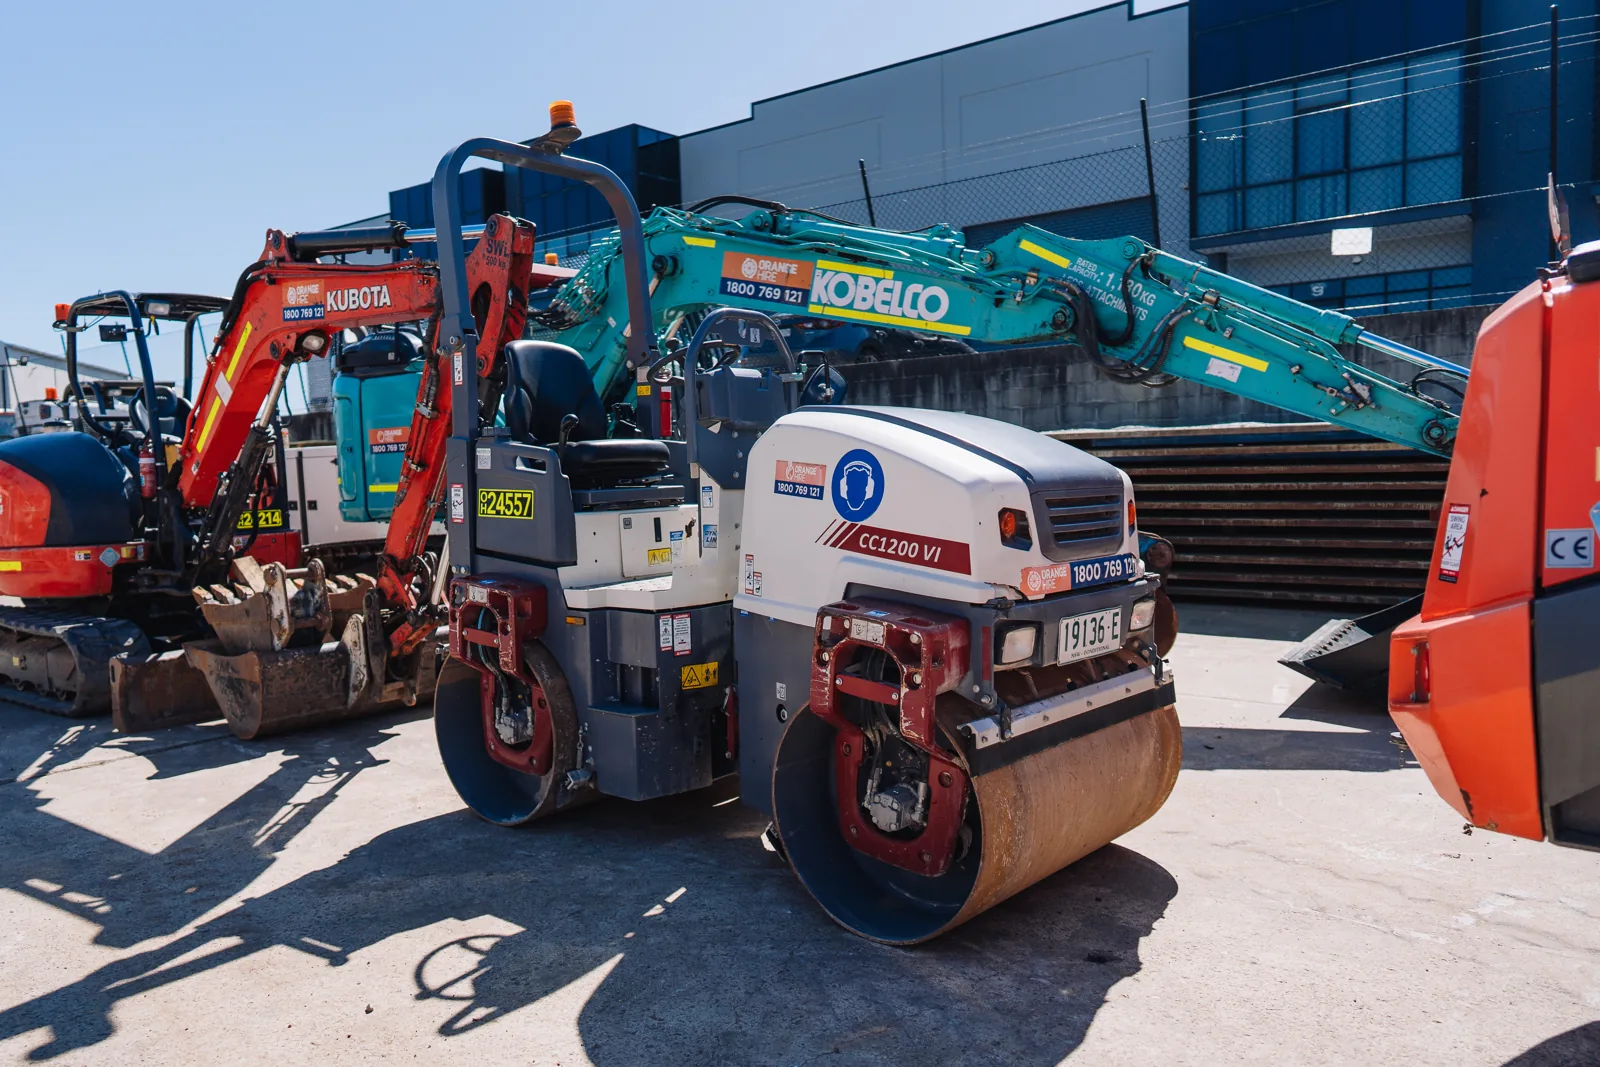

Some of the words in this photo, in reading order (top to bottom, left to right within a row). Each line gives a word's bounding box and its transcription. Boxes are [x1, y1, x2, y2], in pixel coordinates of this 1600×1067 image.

[486, 238, 510, 257] SWL
[486, 255, 497, 267] 500
[758, 259, 798, 275] ORANGE
[1076, 257, 1098, 272] RATED
[757, 270, 778, 283] HIRE
[296, 283, 320, 295] ORANGE
[726, 281, 755, 296] 1800
[758, 285, 781, 300] 769
[784, 289, 803, 303] 121
[810, 268, 950, 322] KOBELCO
[296, 294, 309, 305] HIRE
[326, 284, 392, 312] KUBOTA
[1139, 290, 1157, 307] KG
[284, 309, 300, 320] 1800
[300, 307, 313, 318] 769
[314, 307, 324, 317] 121
[372, 444, 386, 453] 1800
[387, 443, 398, 452] 769
[794, 465, 817, 476] ORANGE
[794, 473, 805, 482] HIRE
[777, 482, 794, 493] 1800
[795, 485, 808, 495] 769
[809, 486, 820, 497] 121
[487, 491, 532, 517] 24557
[859, 533, 919, 558] CC1200
[923, 544, 941, 563] VI
[1550, 536, 1588, 560] CE
[1041, 566, 1067, 579] ORANGE
[1073, 563, 1101, 584] 1800
[1103, 559, 1122, 579] 769
[1041, 580, 1056, 591] HIRE
